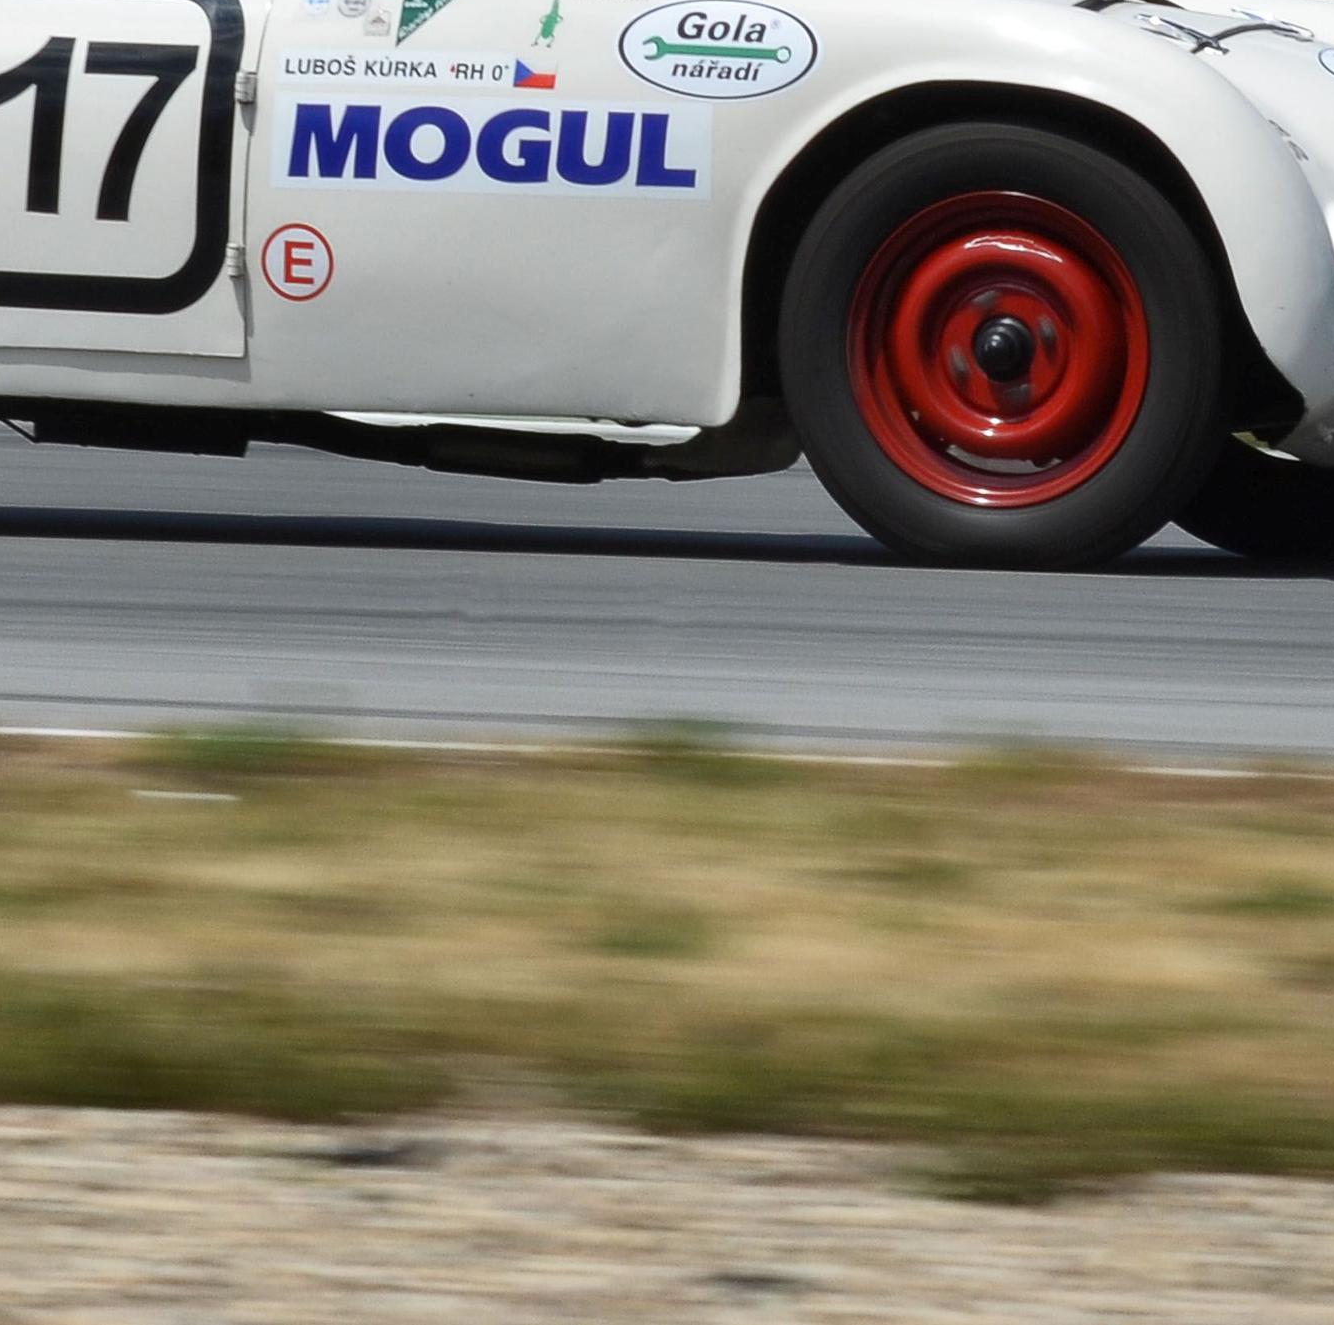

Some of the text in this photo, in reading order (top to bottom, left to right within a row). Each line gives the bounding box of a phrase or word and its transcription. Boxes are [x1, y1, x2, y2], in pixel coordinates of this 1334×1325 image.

[677, 11, 767, 43] Gola
[284, 54, 357, 77] LUBOŠ
[455, 62, 485, 81] RH
[672, 59, 764, 81] nářadí
[287, 103, 698, 188] MOGUL
[283, 240, 315, 285] E
